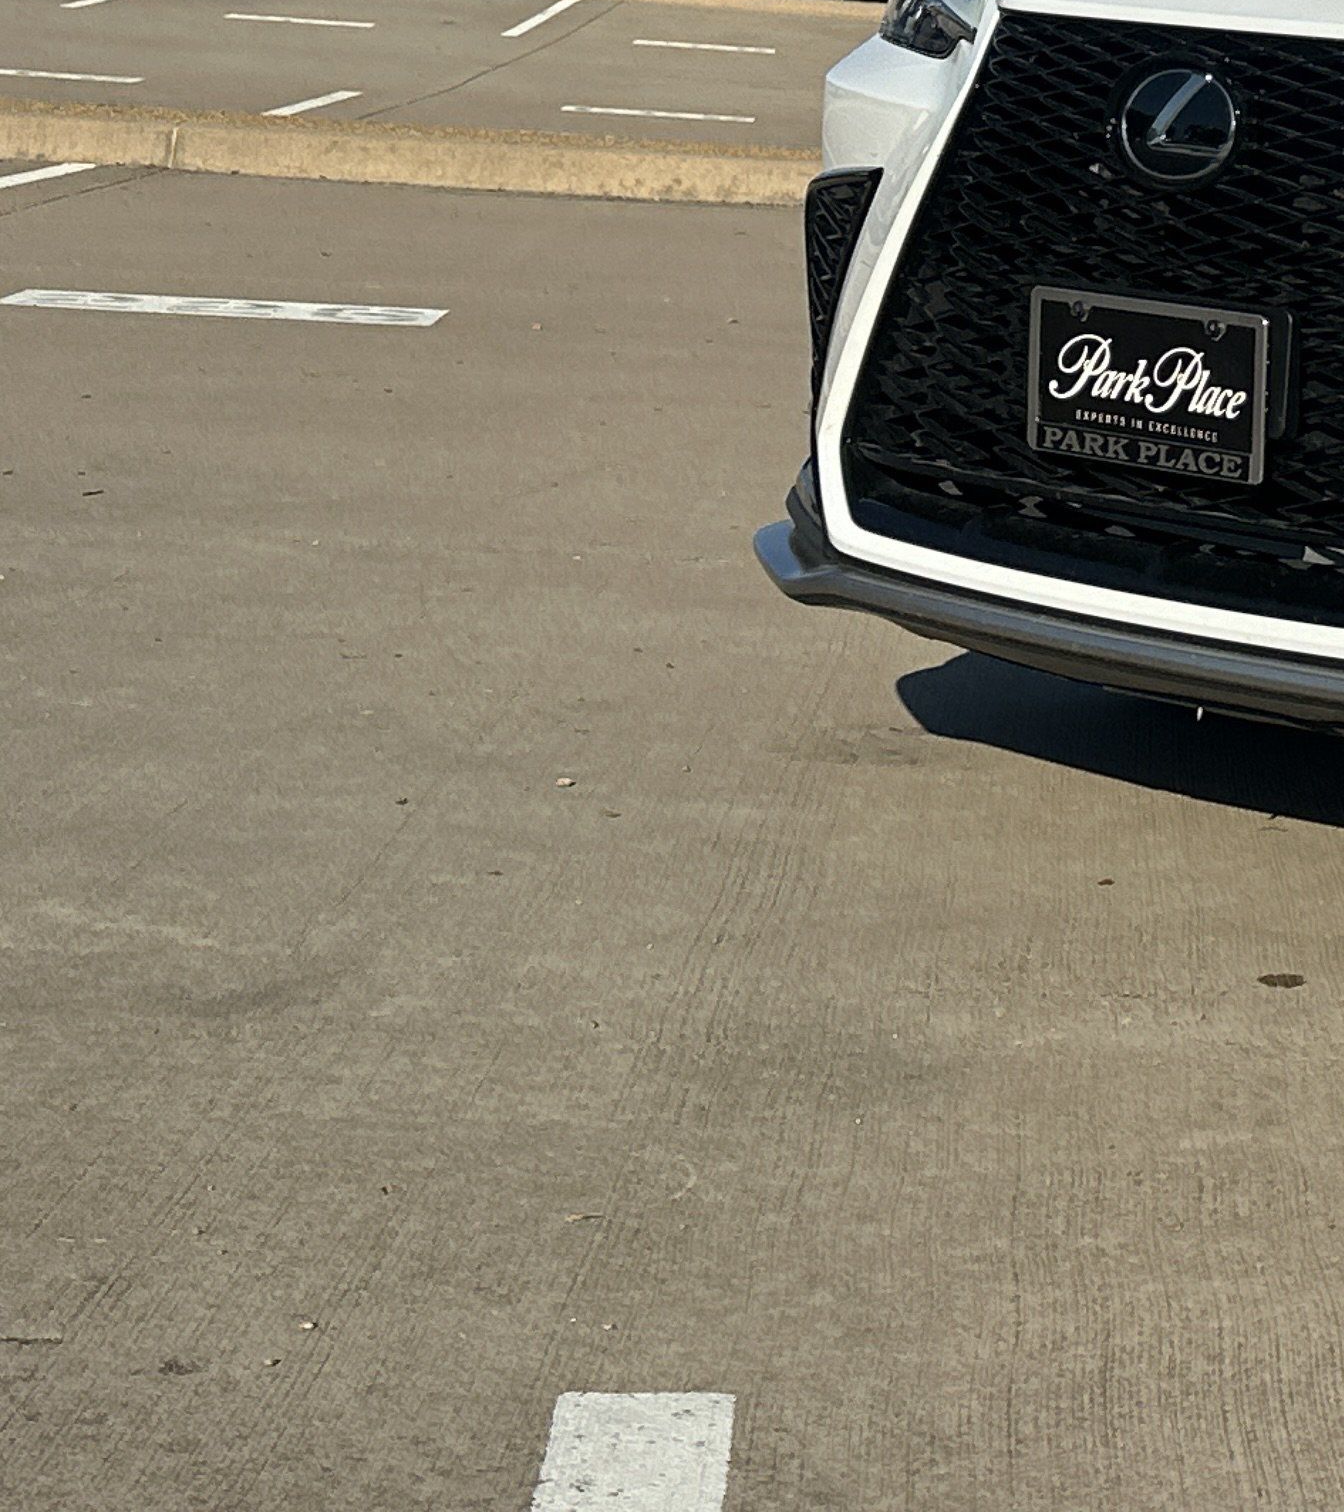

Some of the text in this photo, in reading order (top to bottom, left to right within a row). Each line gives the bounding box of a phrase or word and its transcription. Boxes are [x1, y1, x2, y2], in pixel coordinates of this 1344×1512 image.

[1048, 333, 1248, 419] Park Place
[1043, 425, 1244, 479] PARK PLACE
[1075, 408, 1219, 443] EXPERTS IN EXCELLENCE
